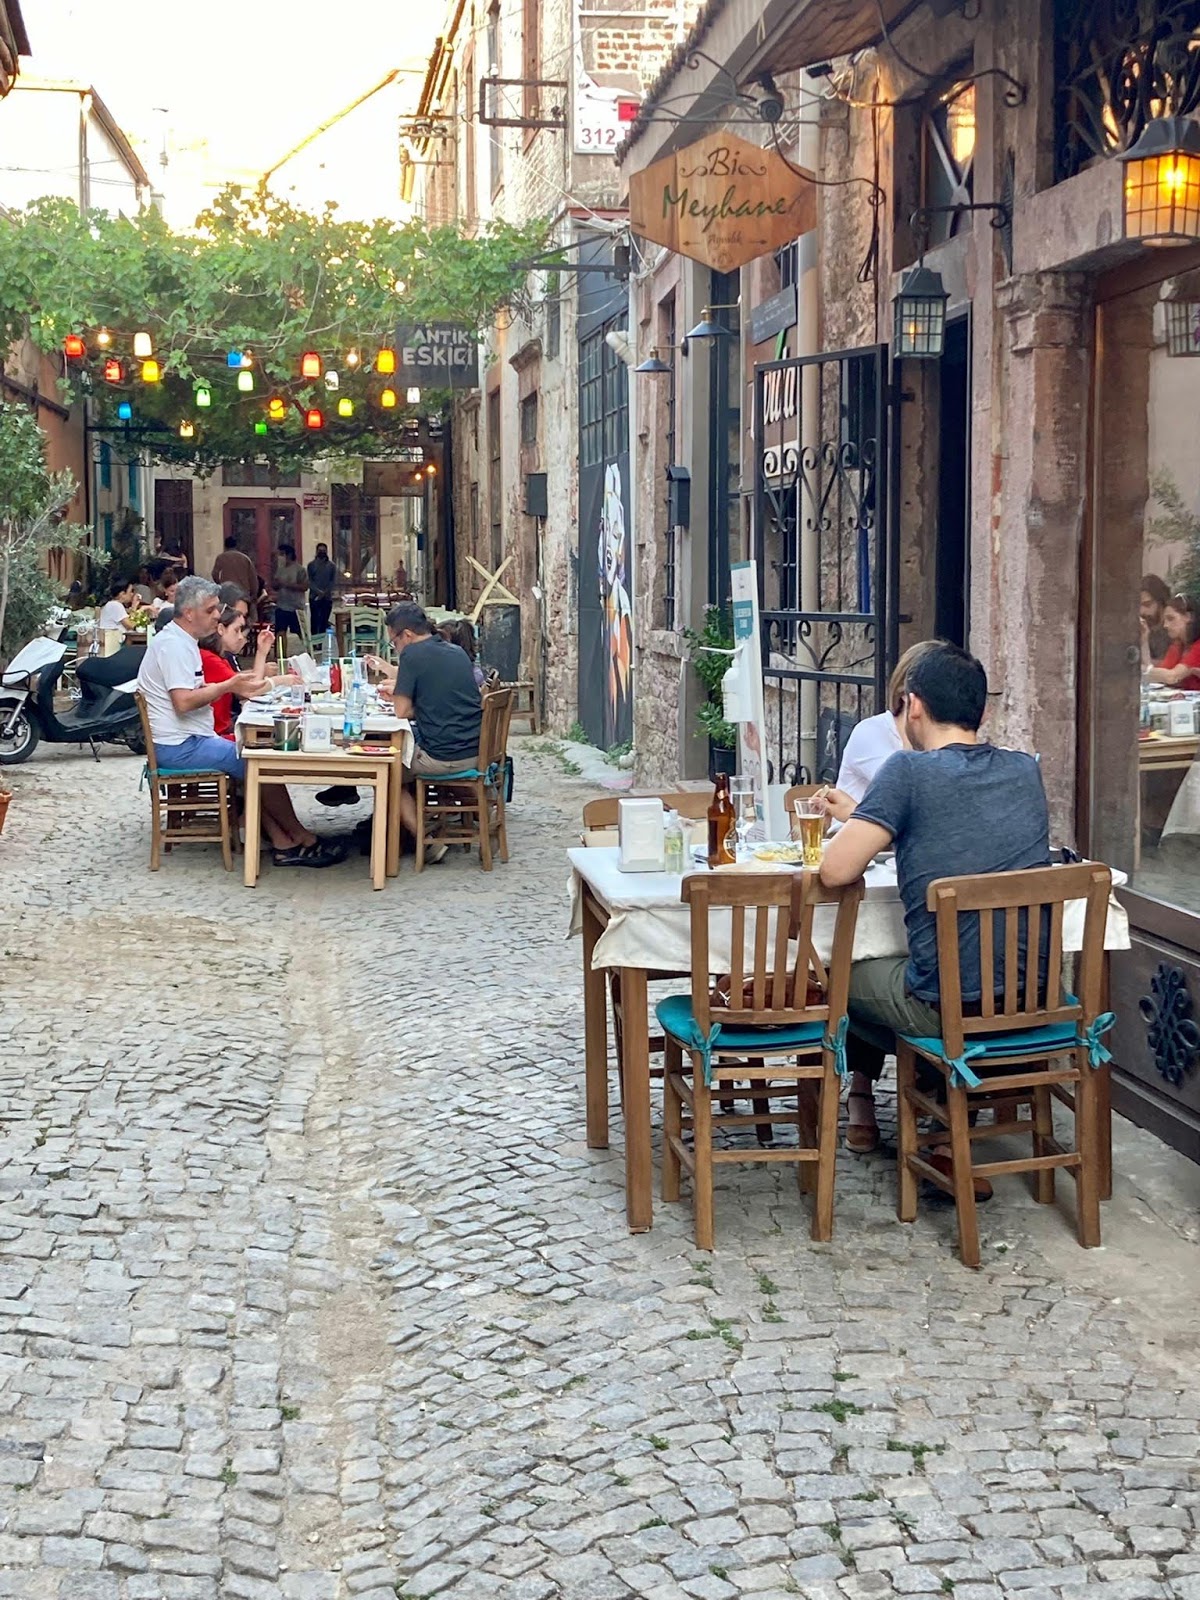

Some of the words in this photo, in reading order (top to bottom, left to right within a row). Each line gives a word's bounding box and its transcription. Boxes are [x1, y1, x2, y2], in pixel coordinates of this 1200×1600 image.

[581, 127, 616, 145] 312
[707, 147, 741, 176] Bi
[662, 184, 787, 233] Meyhane
